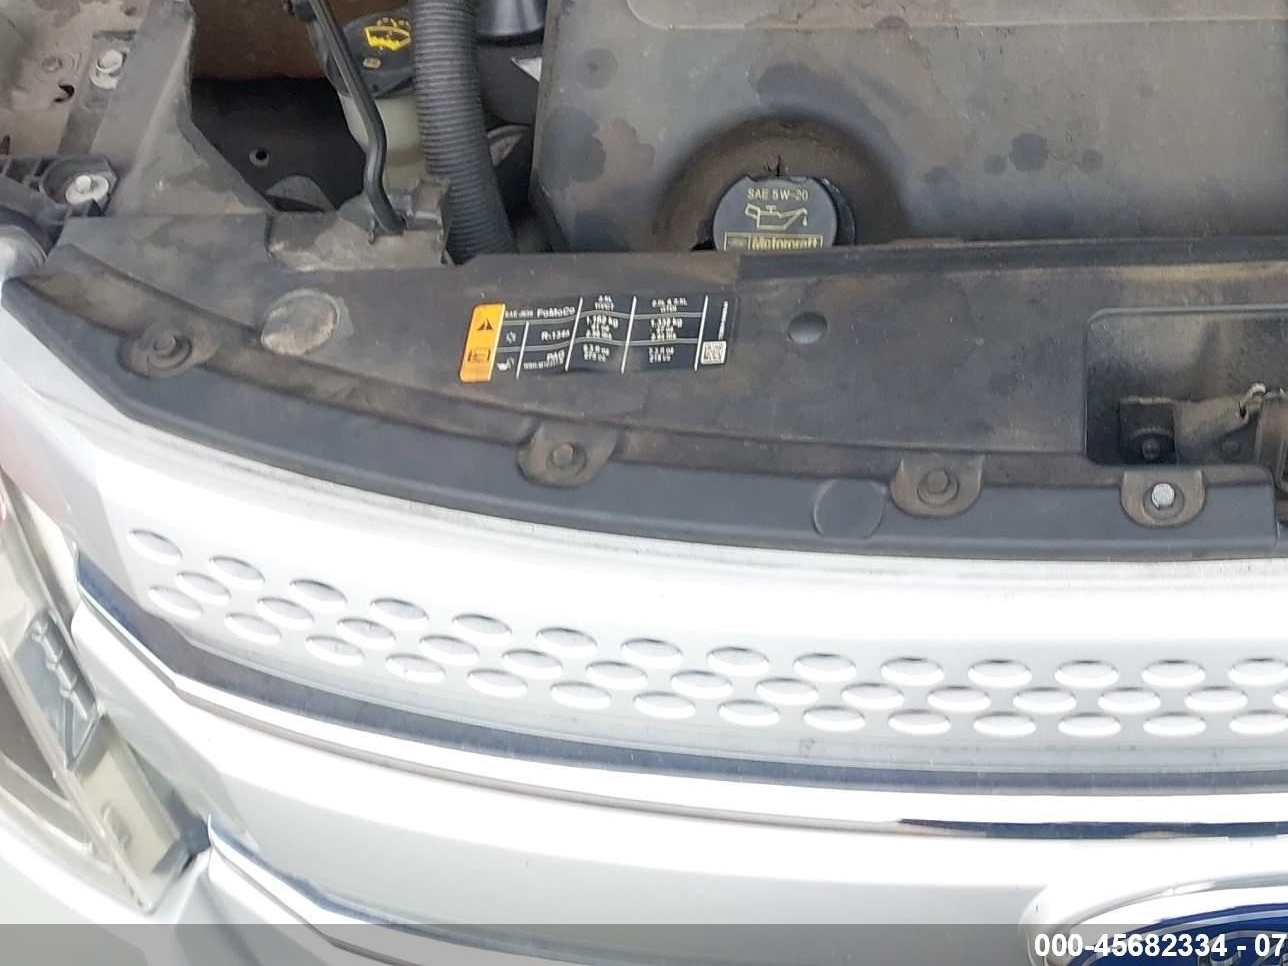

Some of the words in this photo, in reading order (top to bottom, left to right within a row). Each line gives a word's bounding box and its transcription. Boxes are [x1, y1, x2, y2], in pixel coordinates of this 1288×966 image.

[747, 188, 768, 201] SAE
[772, 188, 808, 202] 5W-20
[751, 236, 818, 250] Motorcraft
